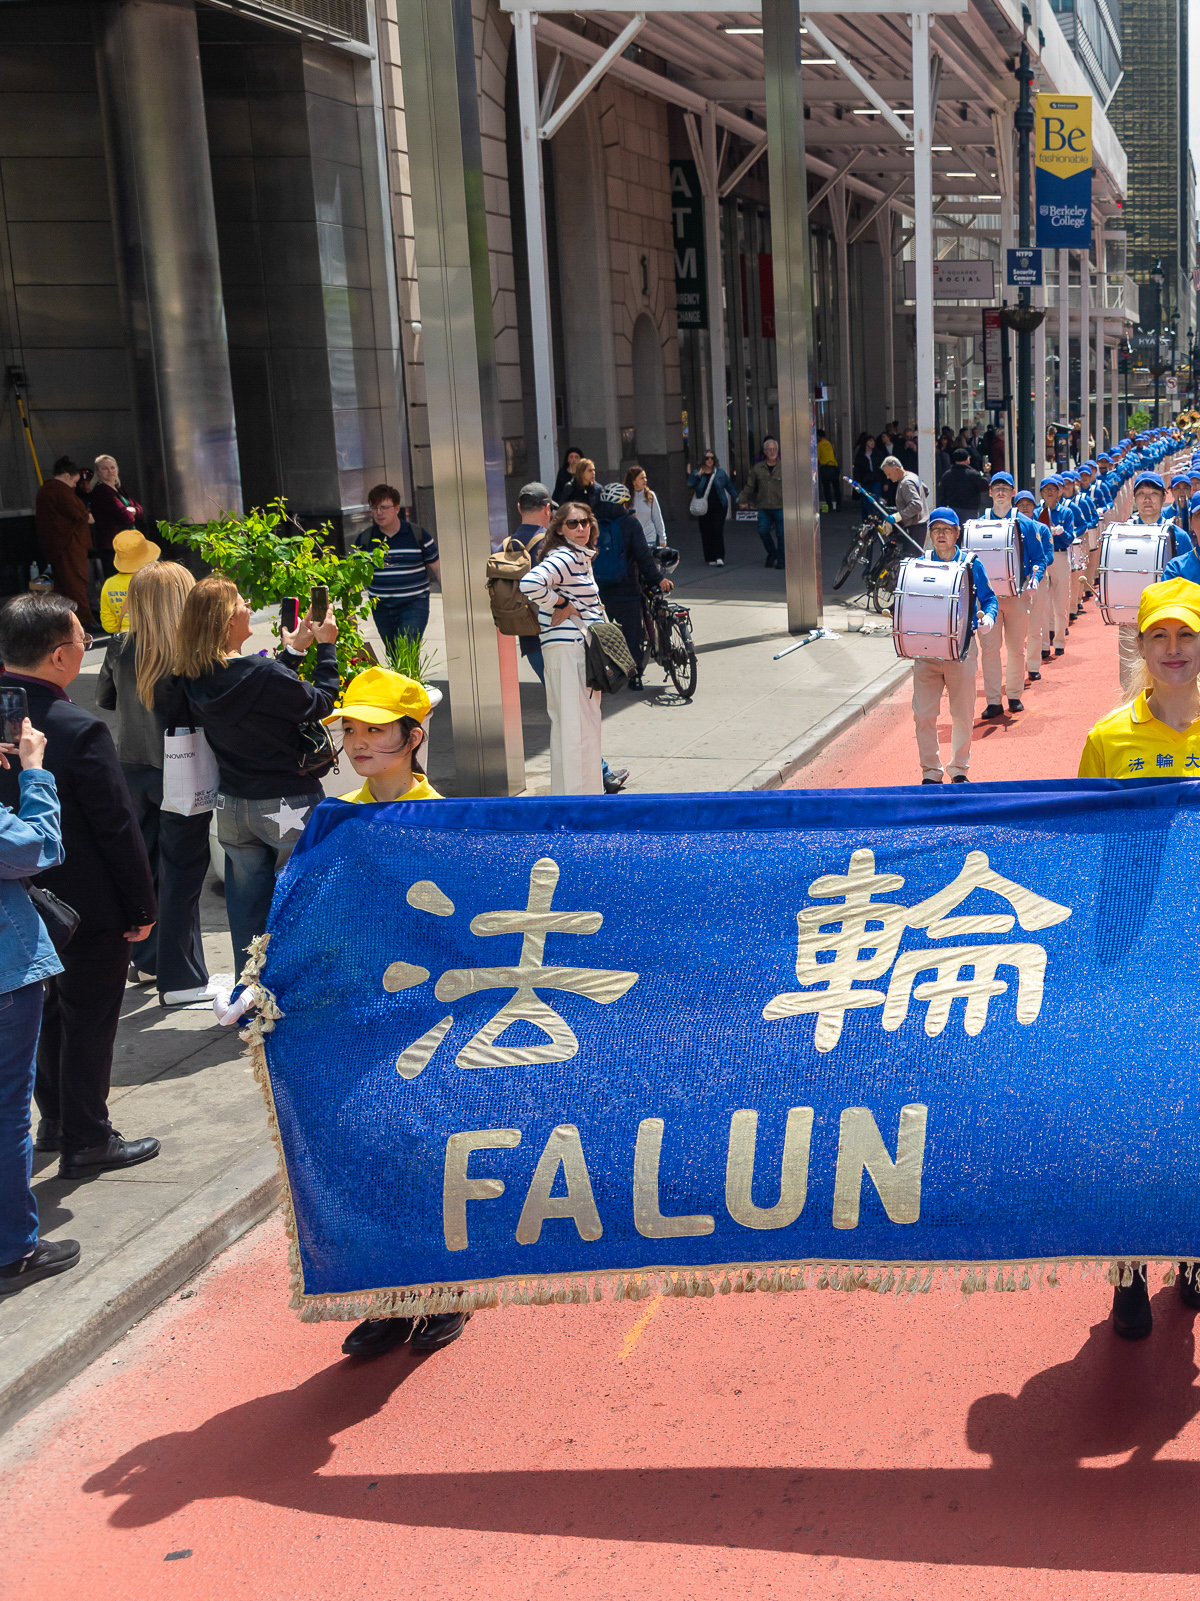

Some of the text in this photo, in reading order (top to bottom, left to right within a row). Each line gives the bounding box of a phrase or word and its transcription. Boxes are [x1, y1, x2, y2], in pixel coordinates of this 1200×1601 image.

[1041, 117, 1086, 153] Be
[1039, 153, 1089, 164] fashionable
[1050, 205, 1087, 218] Berkeley
[671, 167, 697, 279] ATM
[1051, 216, 1085, 228] College
[195, 794, 211, 802] HOUSE
[443, 1103, 928, 1252] FALUN
